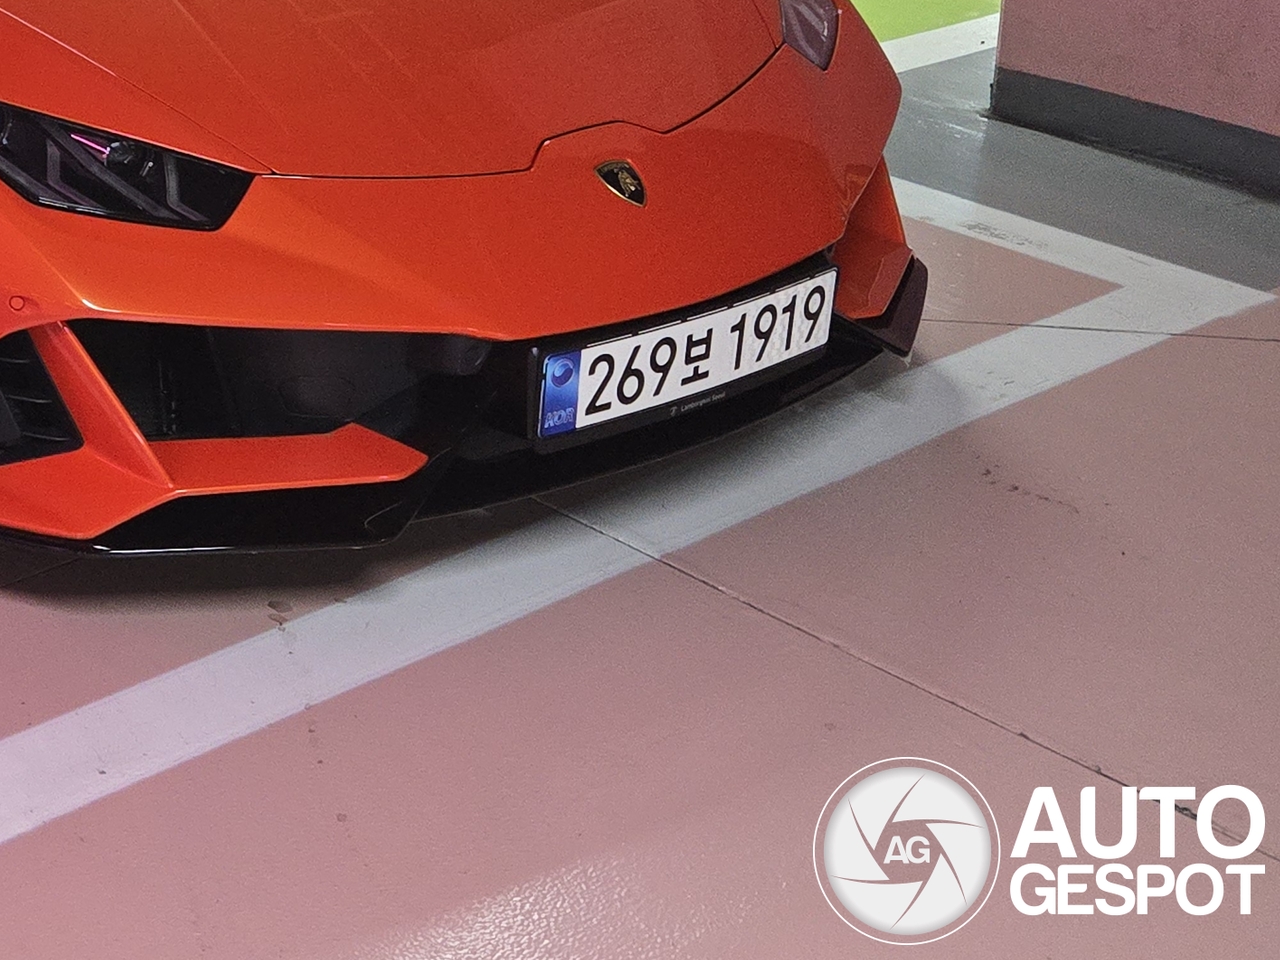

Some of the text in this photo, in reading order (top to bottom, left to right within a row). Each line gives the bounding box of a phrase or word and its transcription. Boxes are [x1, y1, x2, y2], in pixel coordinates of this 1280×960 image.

[584, 284, 827, 417] 269보 1919
[543, 406, 575, 429] KOR
